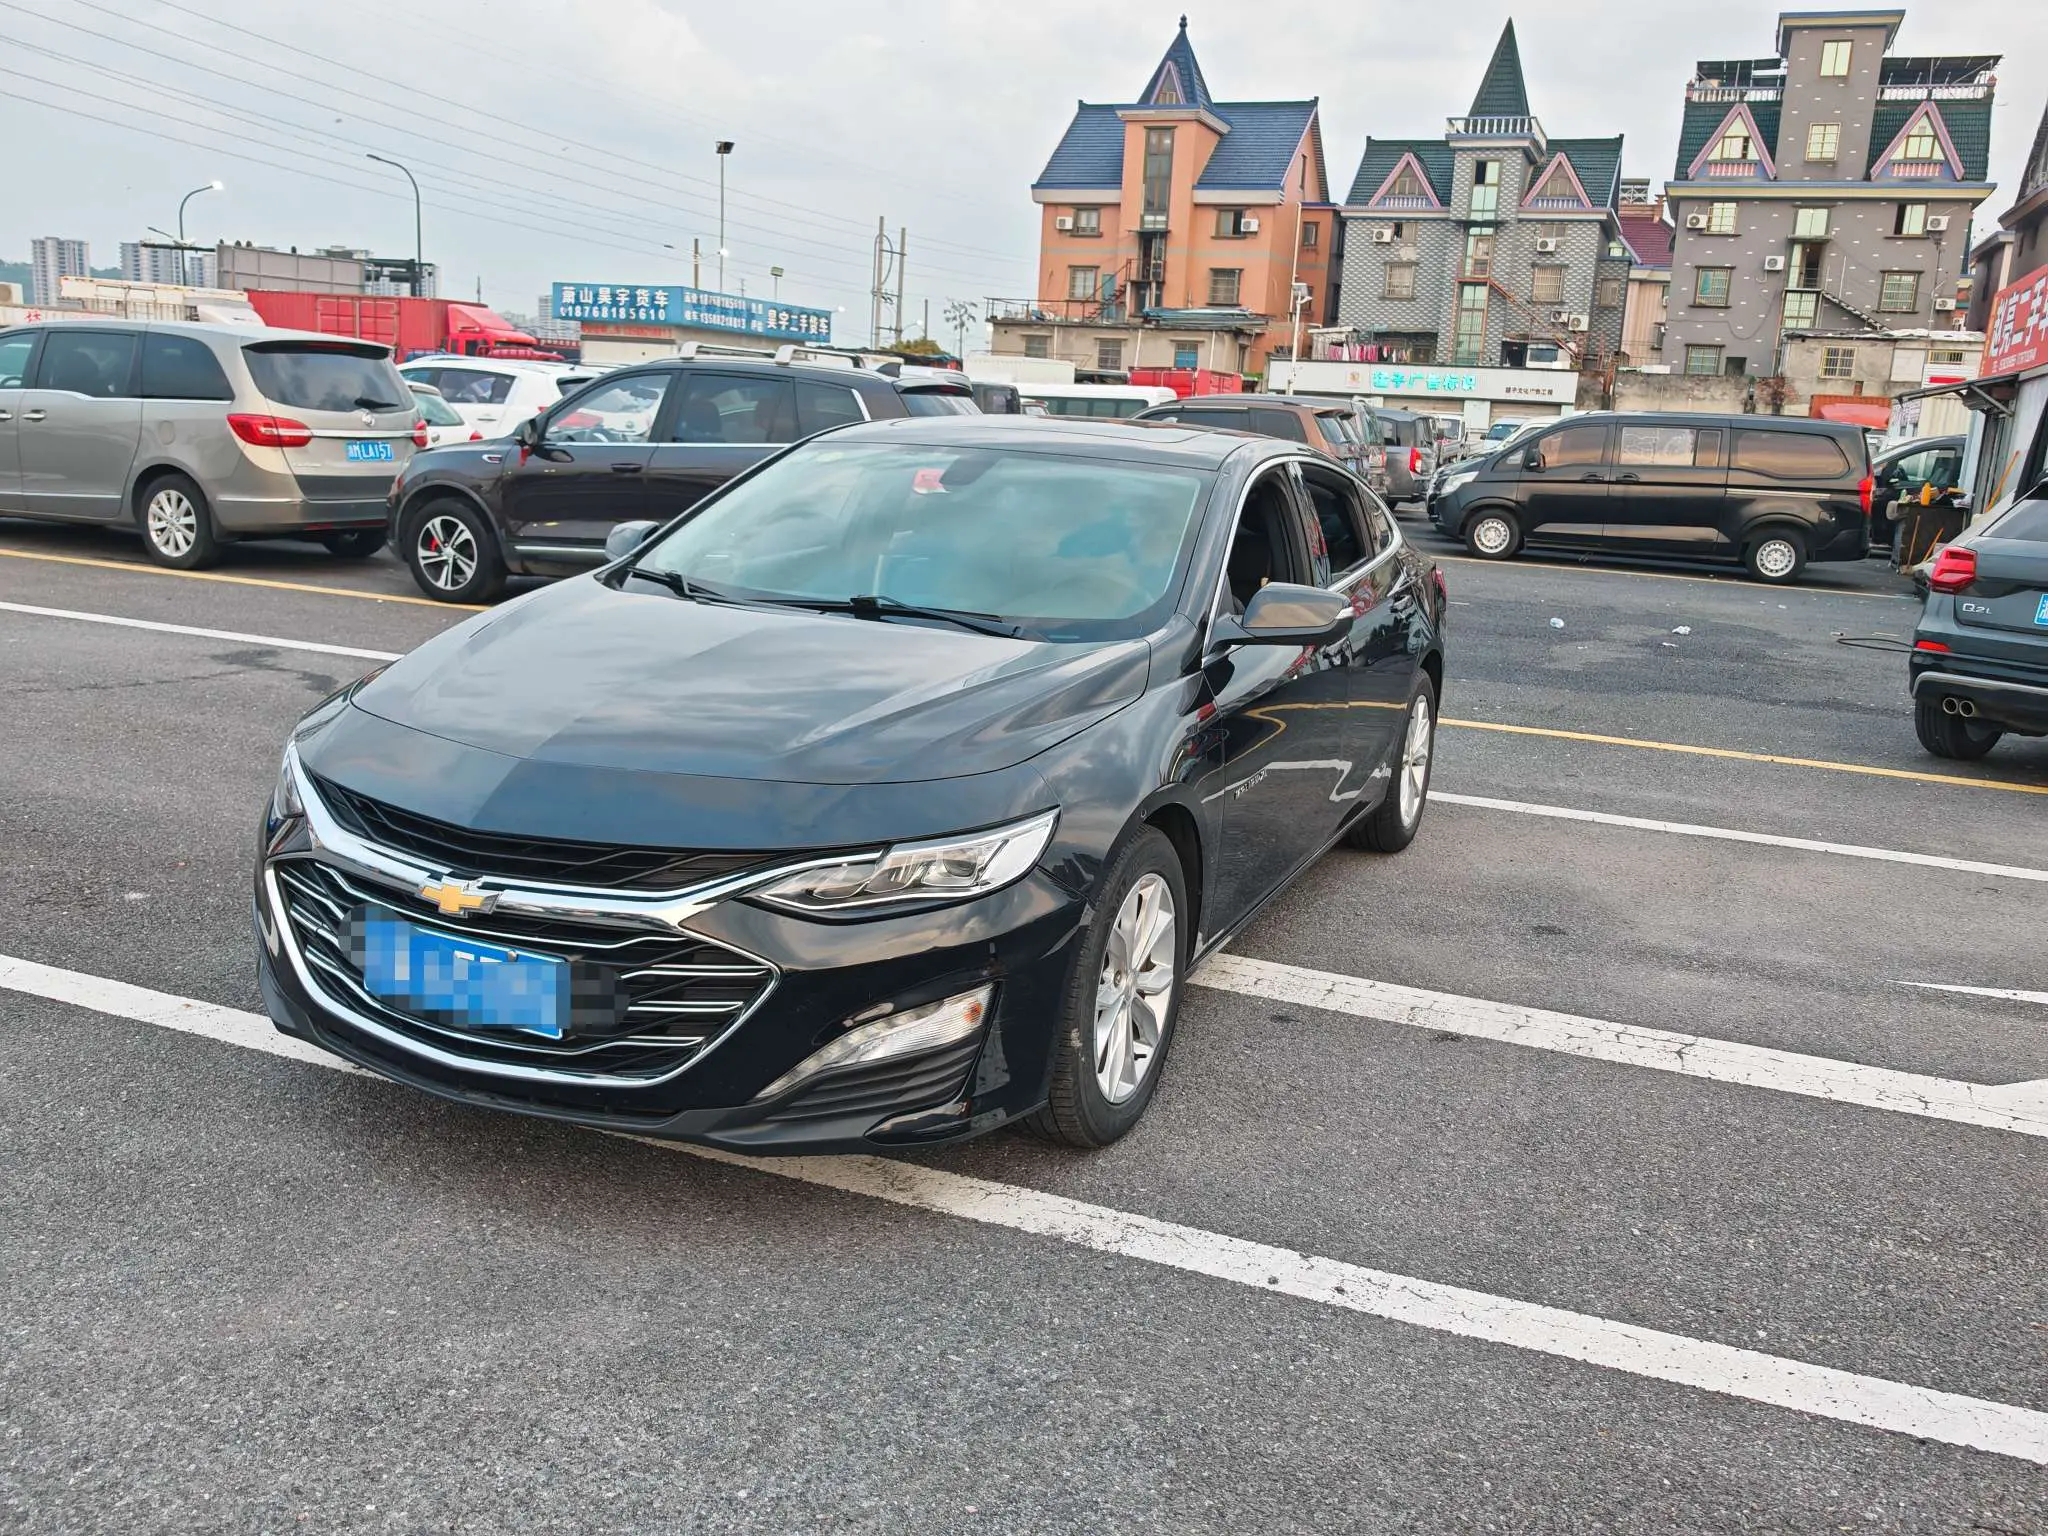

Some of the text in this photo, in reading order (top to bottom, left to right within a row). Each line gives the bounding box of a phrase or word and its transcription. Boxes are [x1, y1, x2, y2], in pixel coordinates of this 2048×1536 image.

[562, 286, 669, 307] 萧山昊宇货车
[568, 306, 666, 320] 18768185610
[767, 309, 829, 336] 昊宇二手货车
